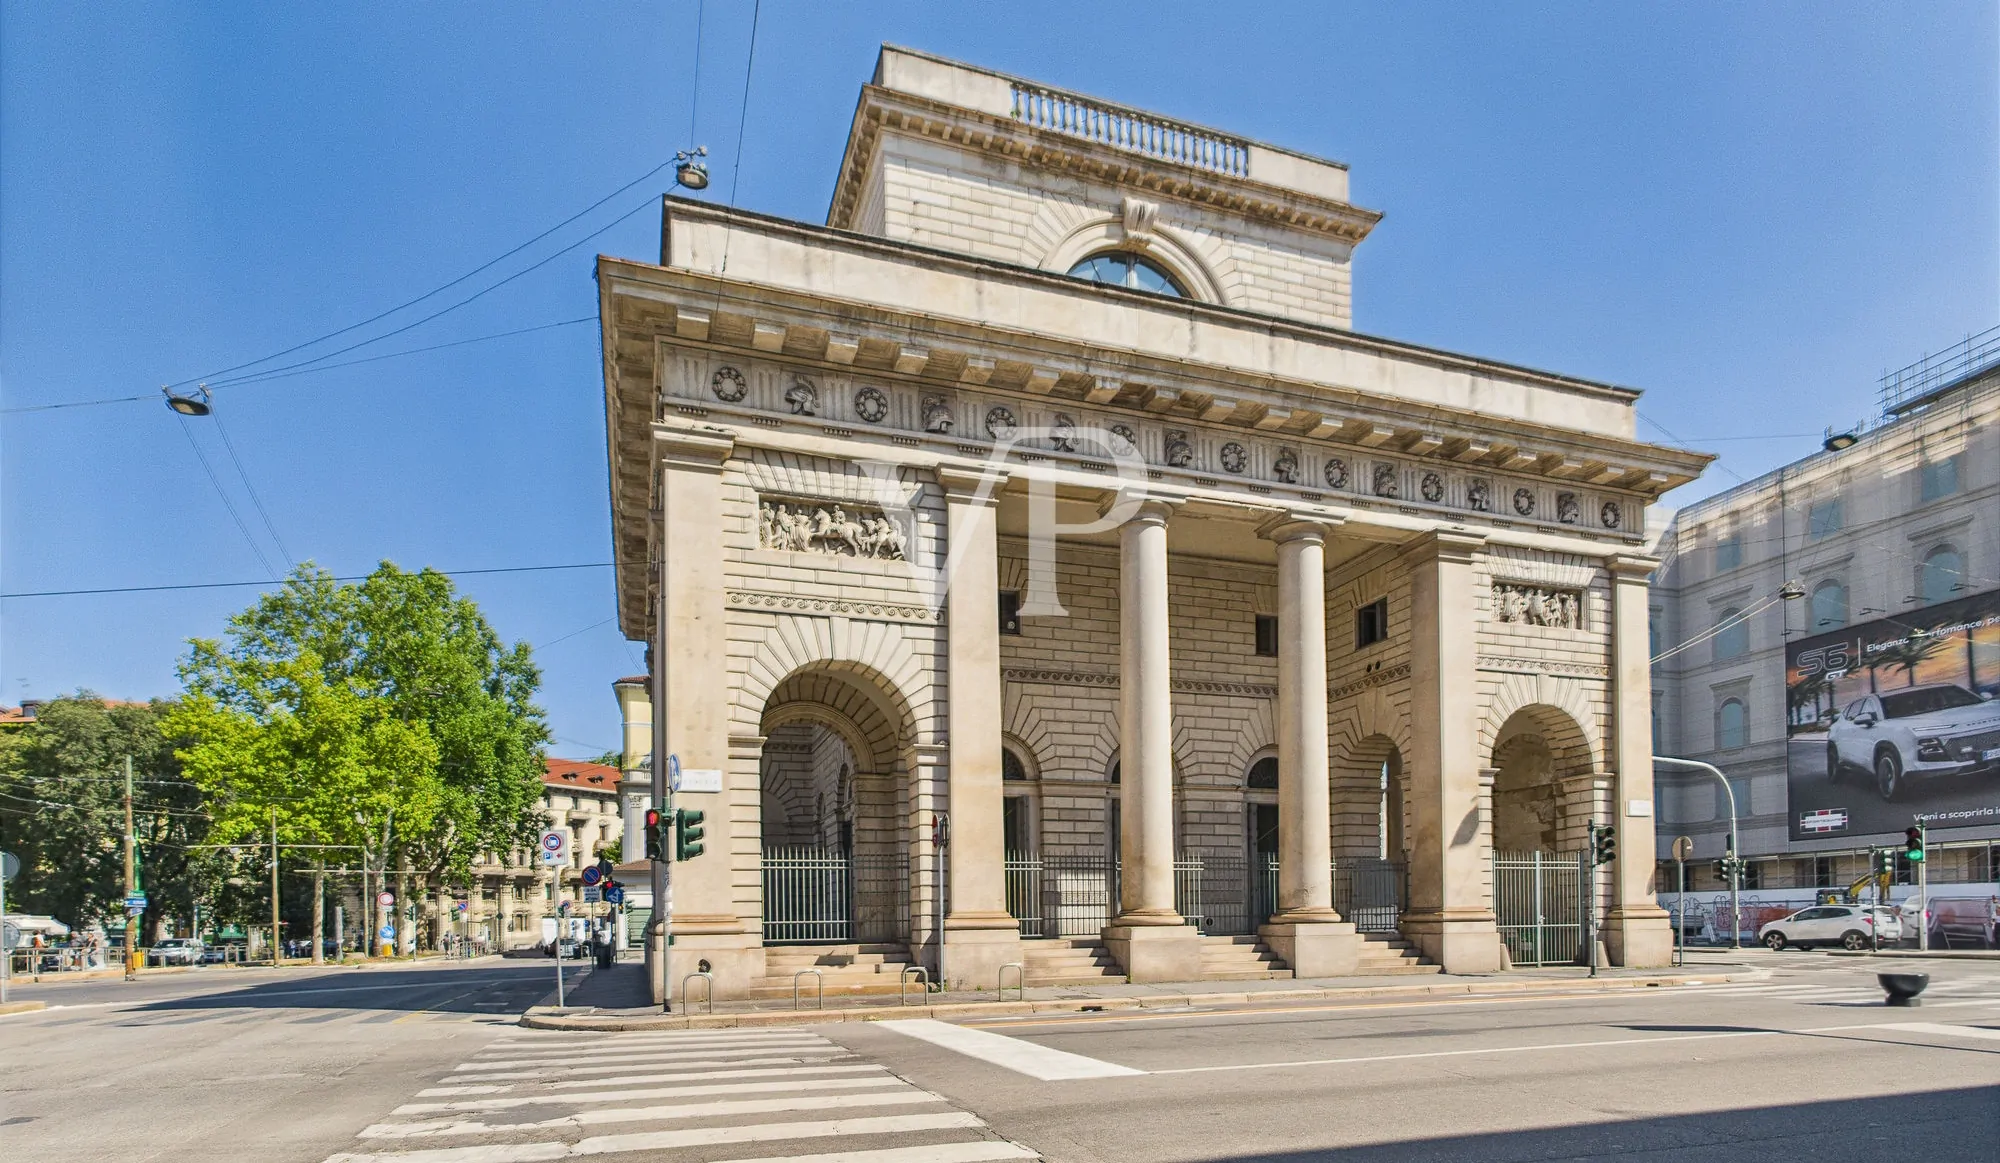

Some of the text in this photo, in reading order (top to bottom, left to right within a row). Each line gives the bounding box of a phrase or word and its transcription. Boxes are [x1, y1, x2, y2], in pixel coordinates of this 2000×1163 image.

[1919, 620, 1985, 637] rfomance,
[1797, 641, 1848, 677] S6
[1825, 669, 1848, 681] GT
[1913, 811, 1938, 821] Vieni
[1947, 807, 1994, 819] scoprirla
